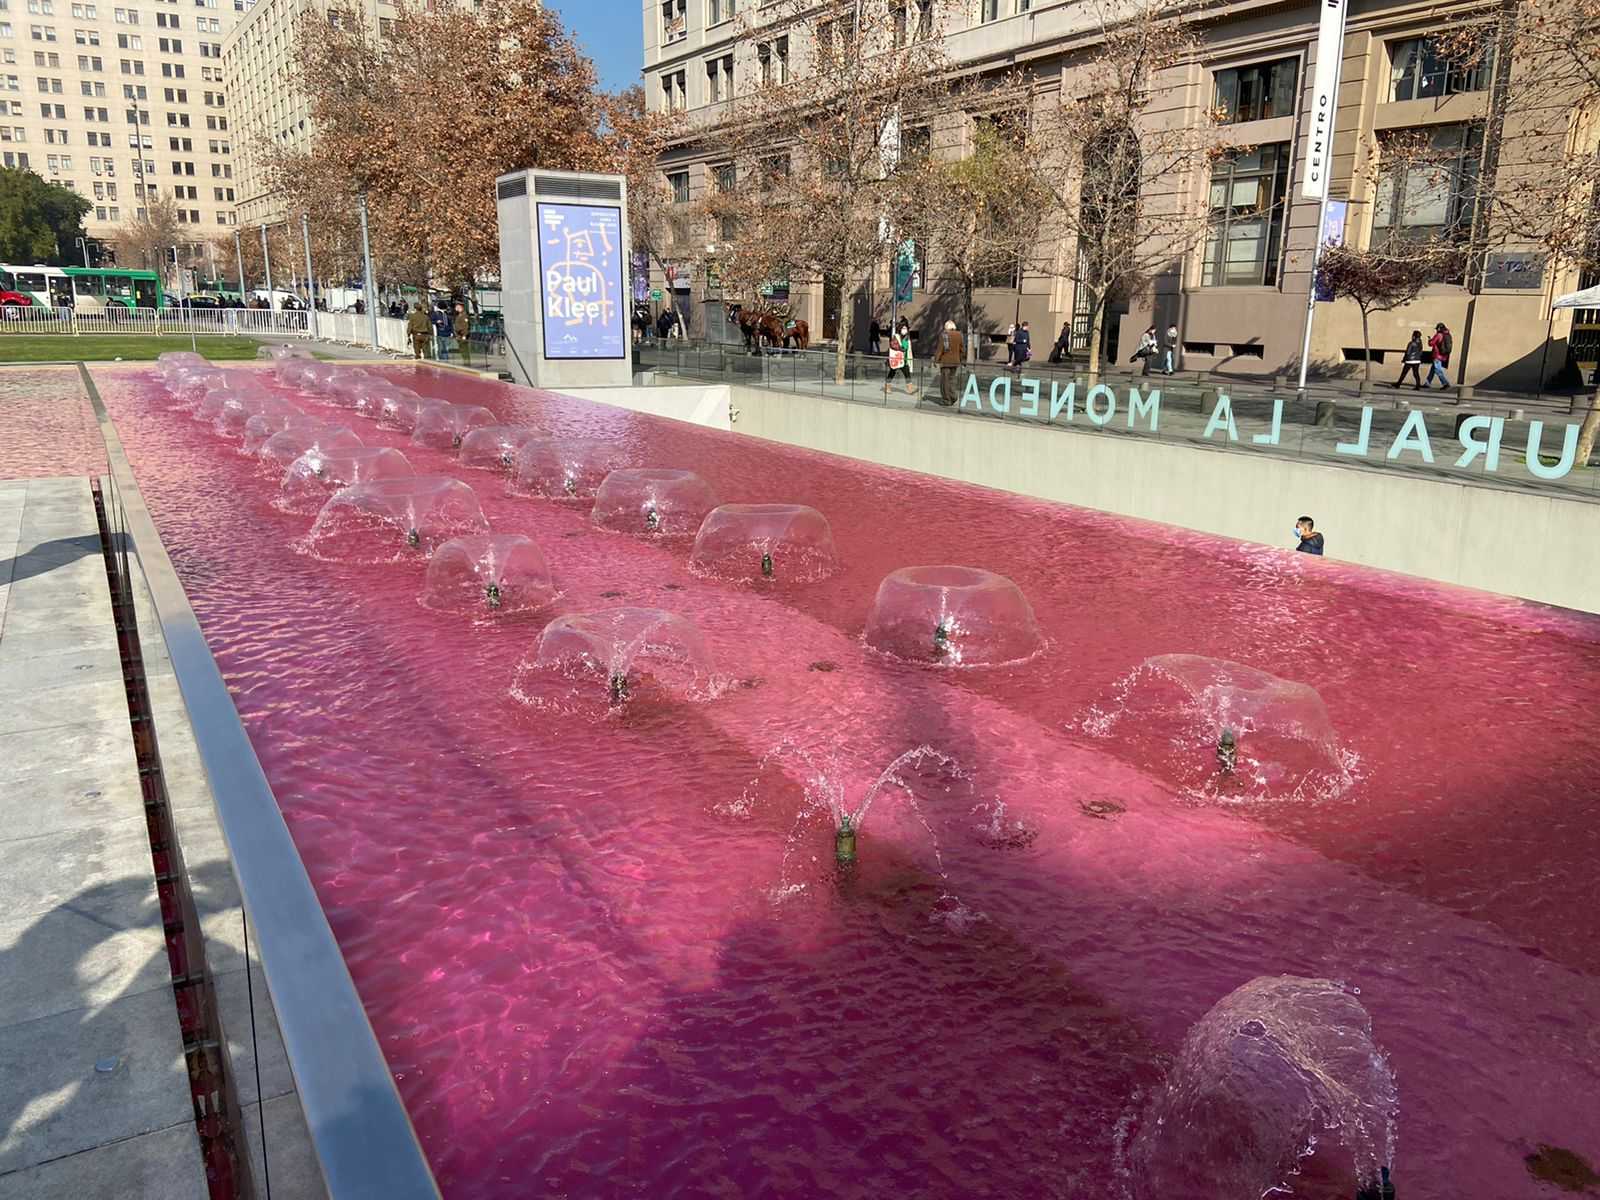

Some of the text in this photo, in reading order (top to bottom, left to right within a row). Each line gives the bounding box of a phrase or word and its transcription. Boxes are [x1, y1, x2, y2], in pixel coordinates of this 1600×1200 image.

[1311, 94, 1327, 182] CENTRO
[546, 270, 597, 294] Paul
[548, 295, 600, 319] Klee
